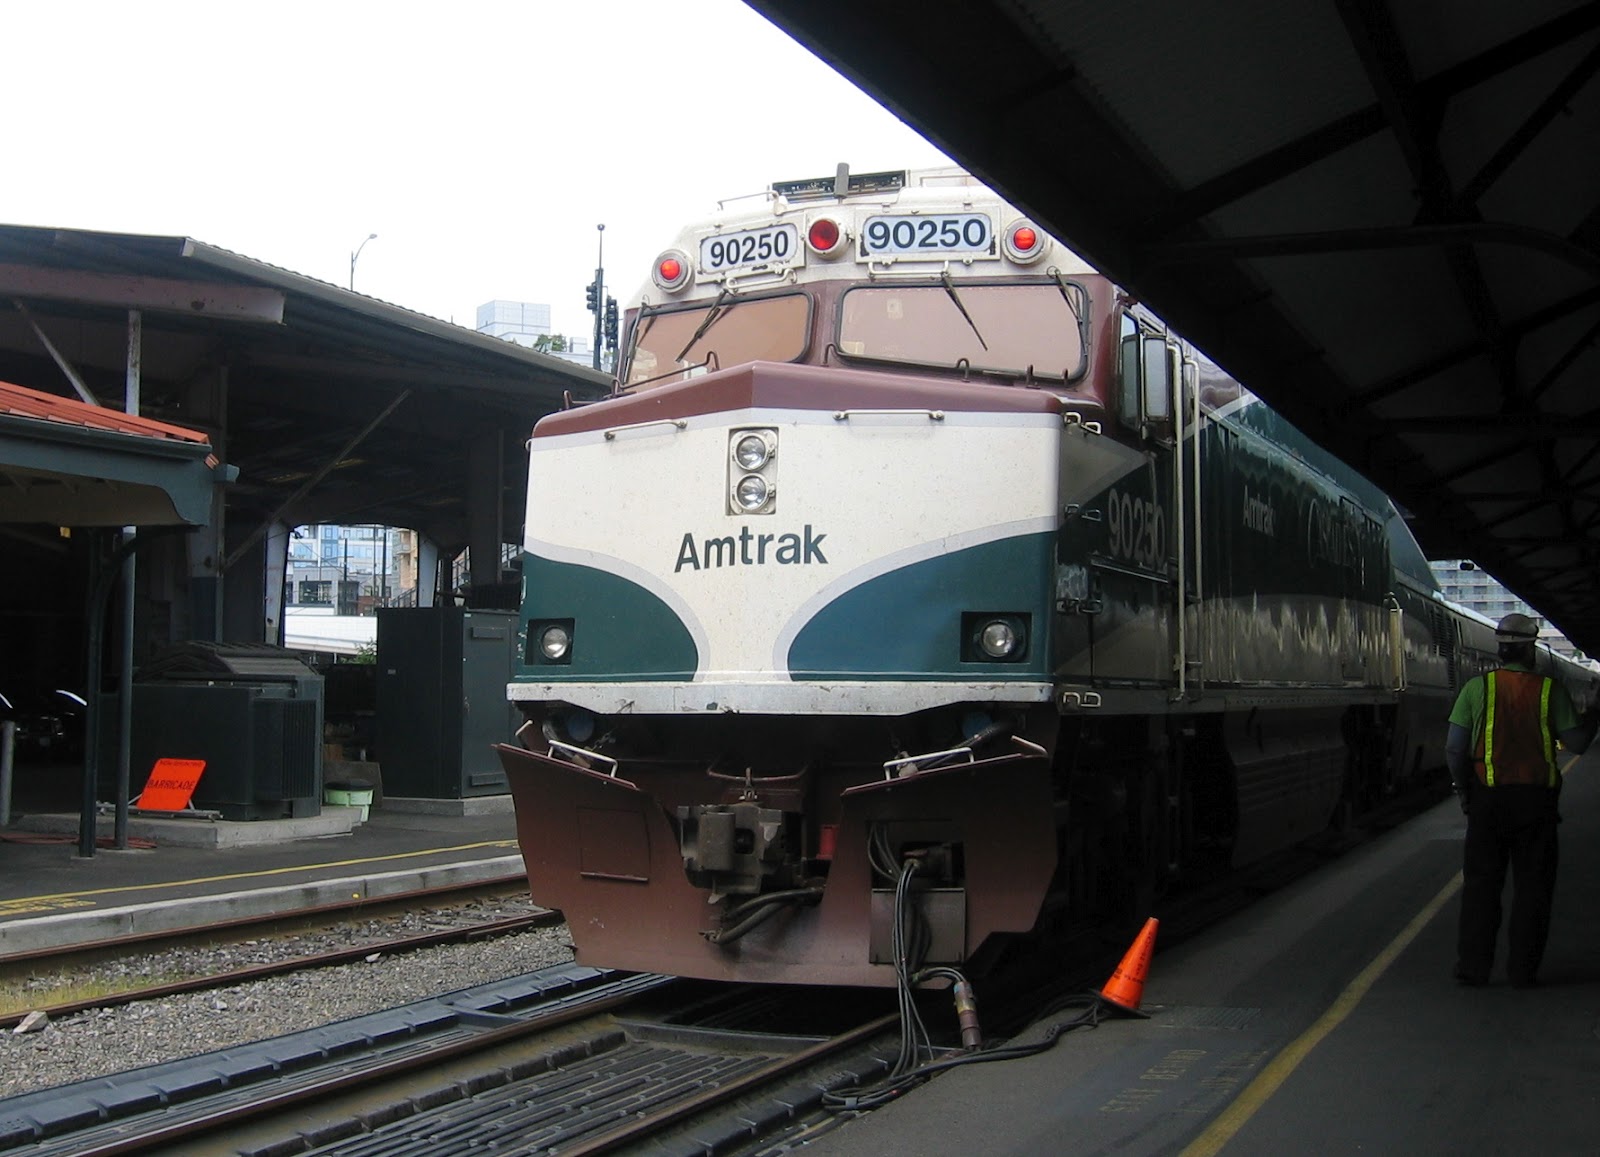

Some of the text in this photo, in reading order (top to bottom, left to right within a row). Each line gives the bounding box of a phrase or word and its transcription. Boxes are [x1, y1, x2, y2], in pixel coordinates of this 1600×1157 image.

[710, 230, 789, 267] 90250
[868, 218, 987, 250] 90250
[1108, 488, 1166, 568] 90250
[1243, 484, 1275, 537] Amtrak
[674, 524, 829, 573] Amtrak
[147, 779, 195, 790] BARRICADE
